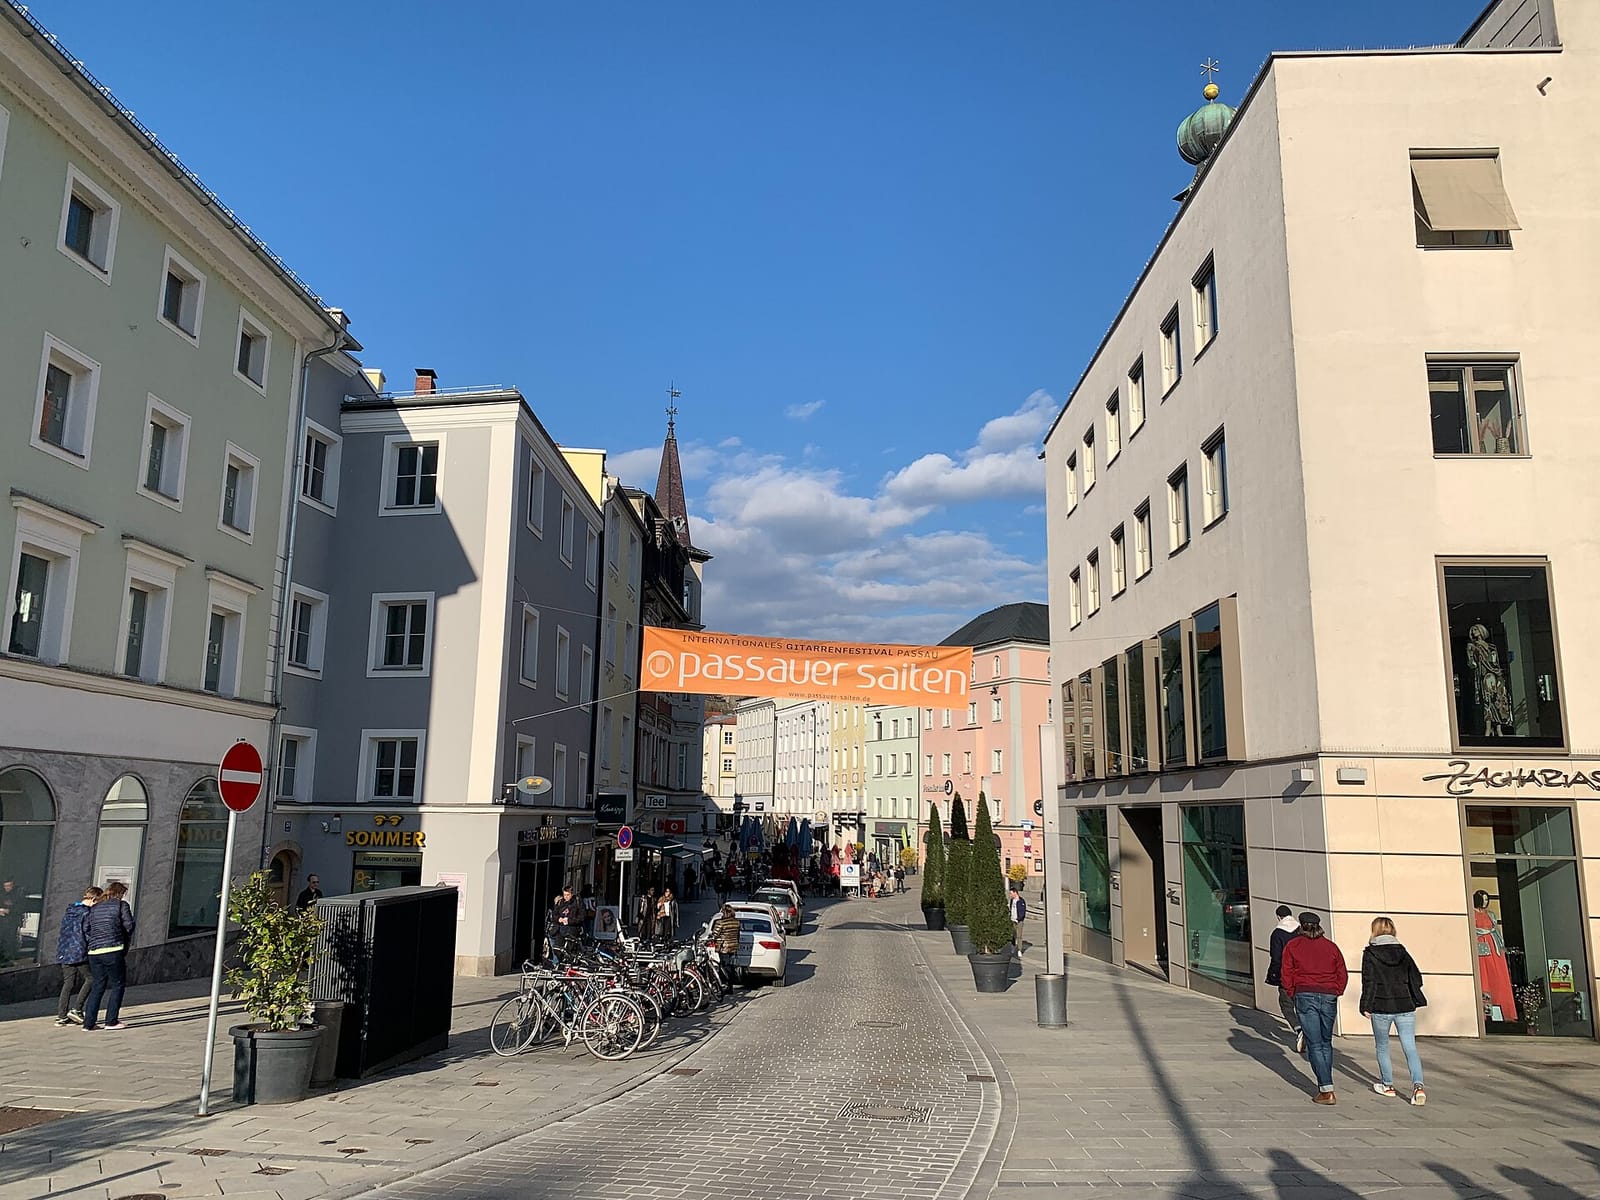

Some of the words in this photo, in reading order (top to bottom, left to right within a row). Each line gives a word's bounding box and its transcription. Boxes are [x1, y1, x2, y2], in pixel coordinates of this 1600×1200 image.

[682, 634, 783, 650] INTERNATIONALES
[786, 643, 893, 657] GITARRENFESTIVAL
[897, 649, 939, 660] PASSAU
[678, 652, 849, 688] passauer
[856, 662, 967, 696] saiten
[647, 796, 665, 807] Tee
[345, 830, 426, 848] SOMMER
